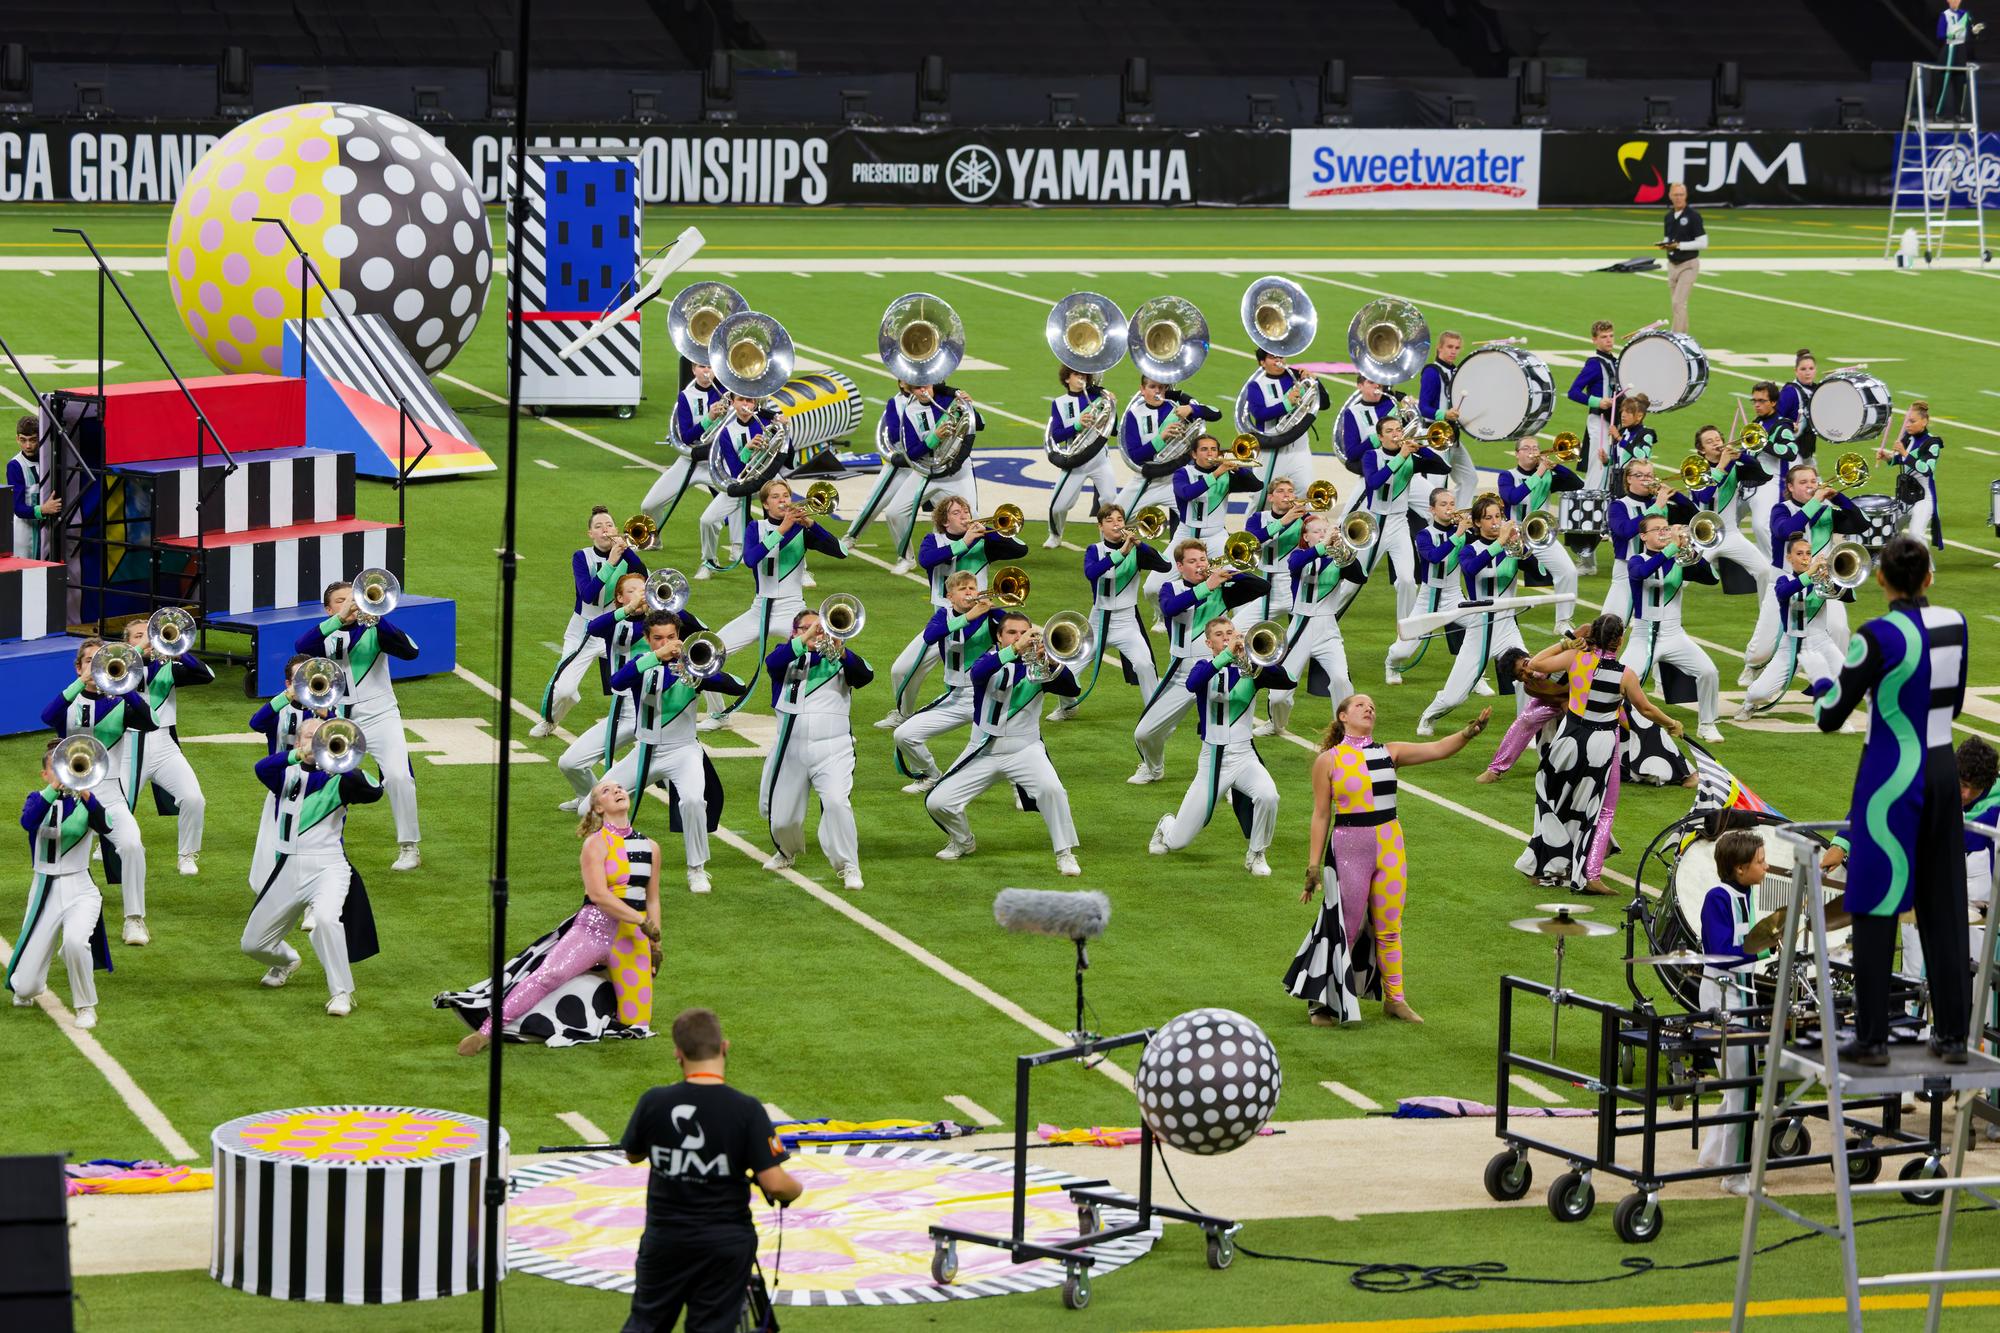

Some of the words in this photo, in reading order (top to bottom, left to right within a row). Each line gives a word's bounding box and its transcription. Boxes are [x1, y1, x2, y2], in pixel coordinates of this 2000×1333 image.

[472, 135, 829, 205] CONSHIPS
[852, 163, 920, 184] PRESENTED
[922, 163, 940, 184] BY
[1005, 148, 1192, 201] YAMAHA
[1312, 146, 1525, 184] Sweetwater
[1667, 141, 1807, 193] FJM
[651, 1145, 731, 1177] FJM
